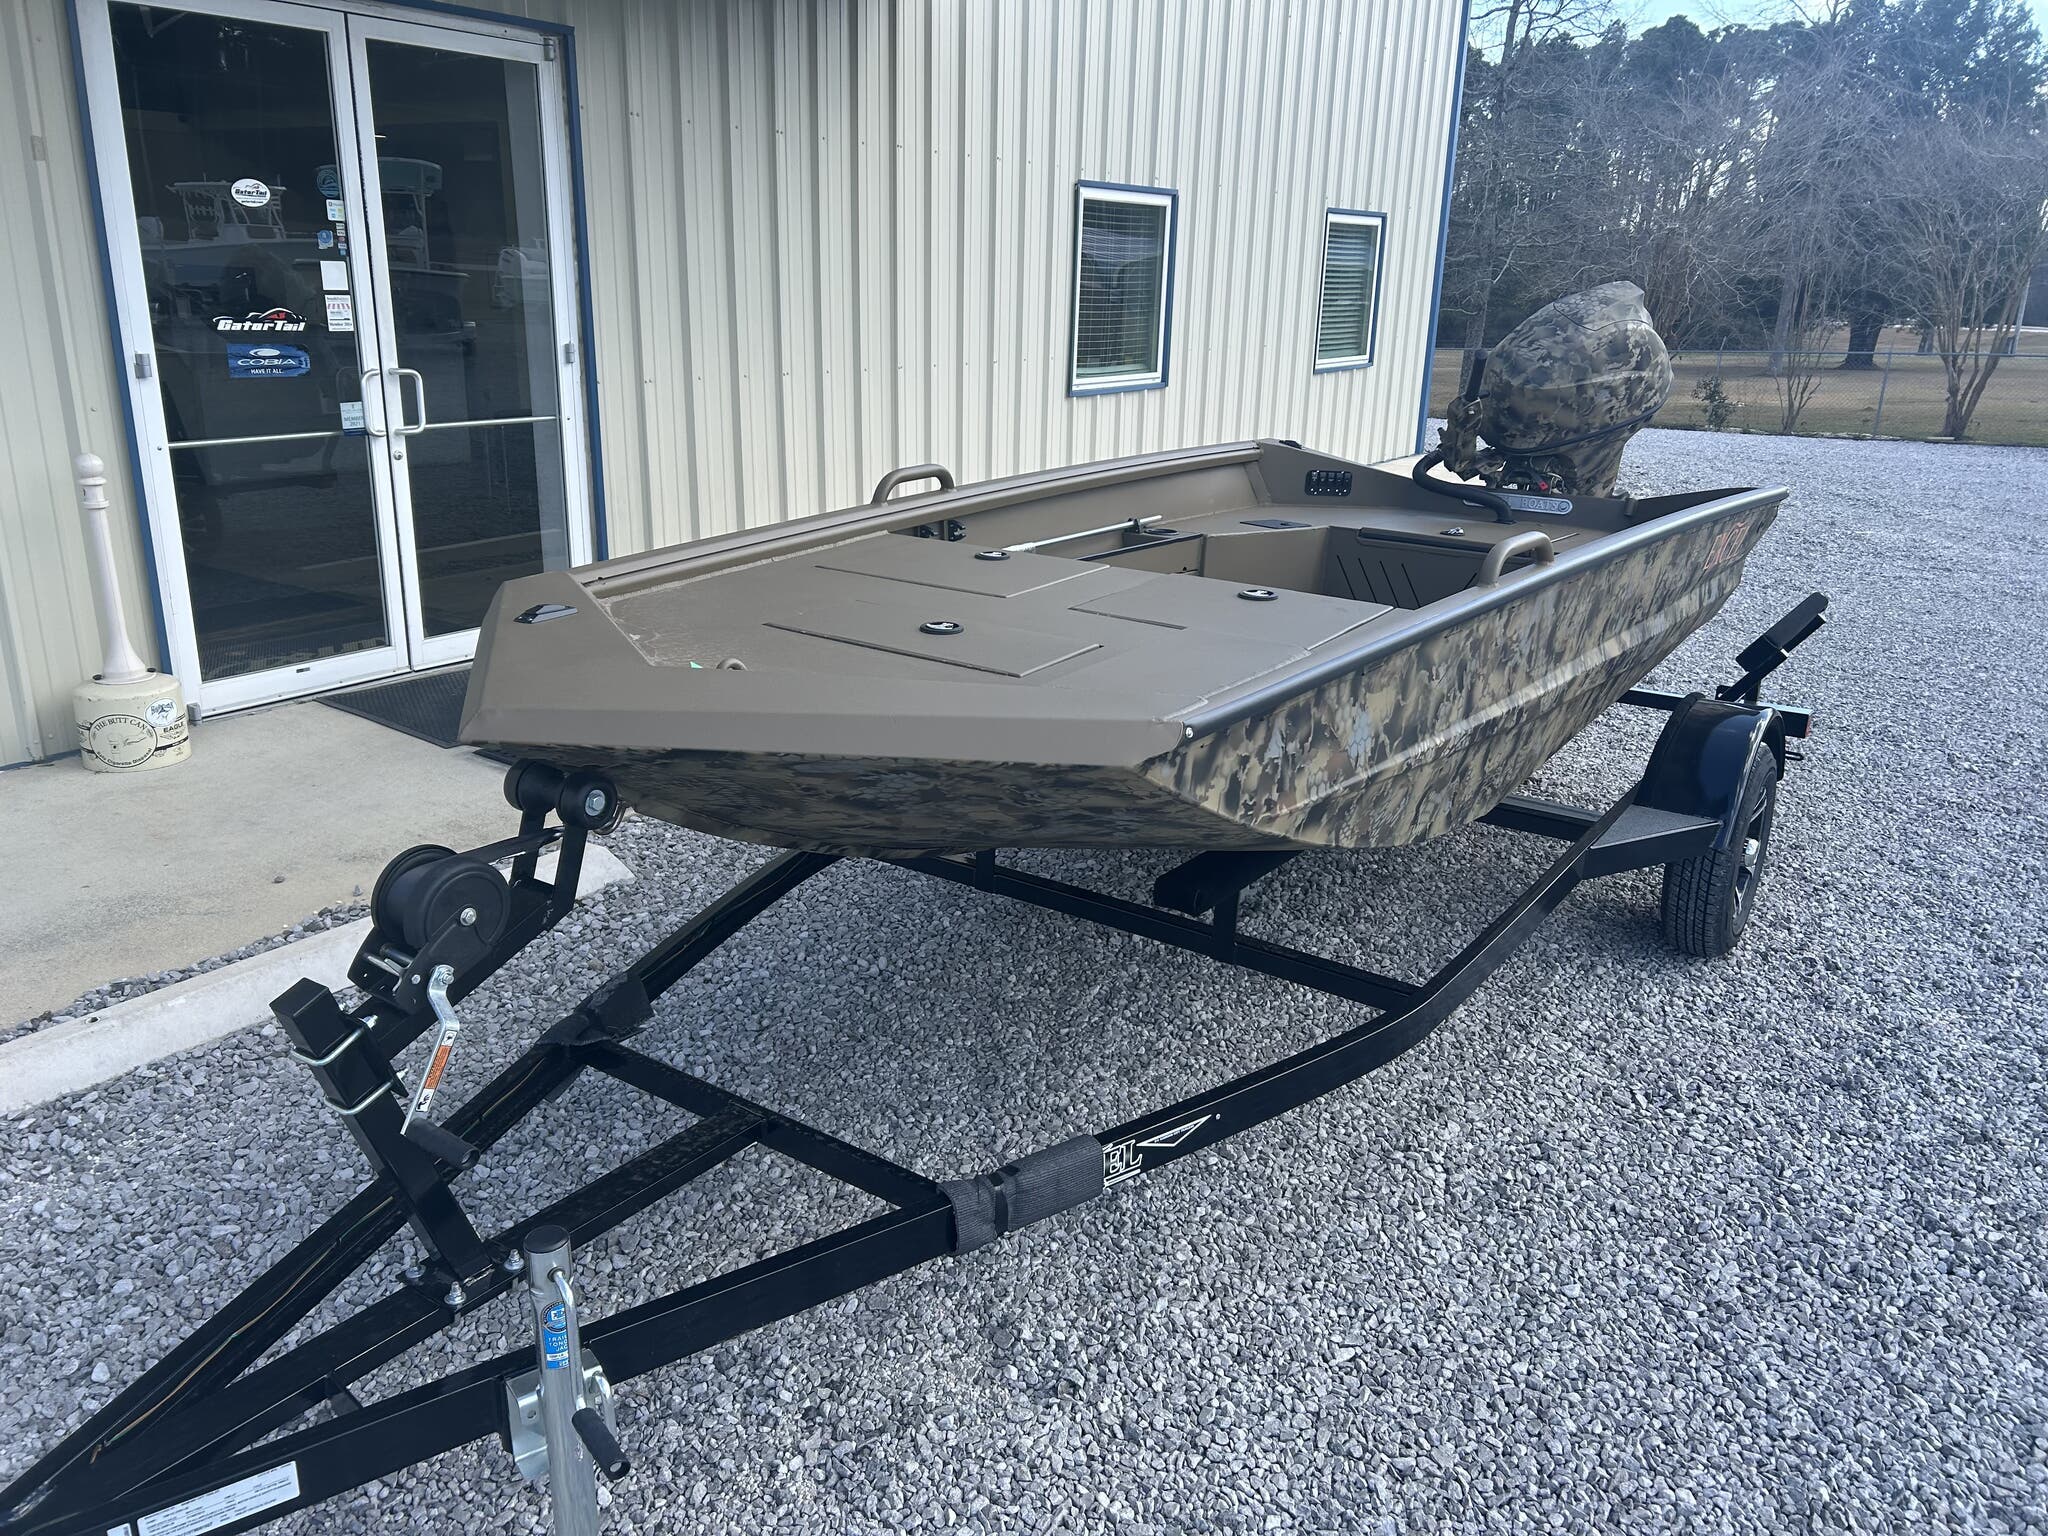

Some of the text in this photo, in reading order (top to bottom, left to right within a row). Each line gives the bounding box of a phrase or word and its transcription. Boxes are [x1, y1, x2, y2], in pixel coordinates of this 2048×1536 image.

[217, 320, 305, 331] GatorTail
[237, 358, 296, 366] COBIA
[94, 717, 148, 731] THE BUTT CAN
[548, 1334, 567, 1342] TRAIL
[549, 1339, 568, 1347] TONG
